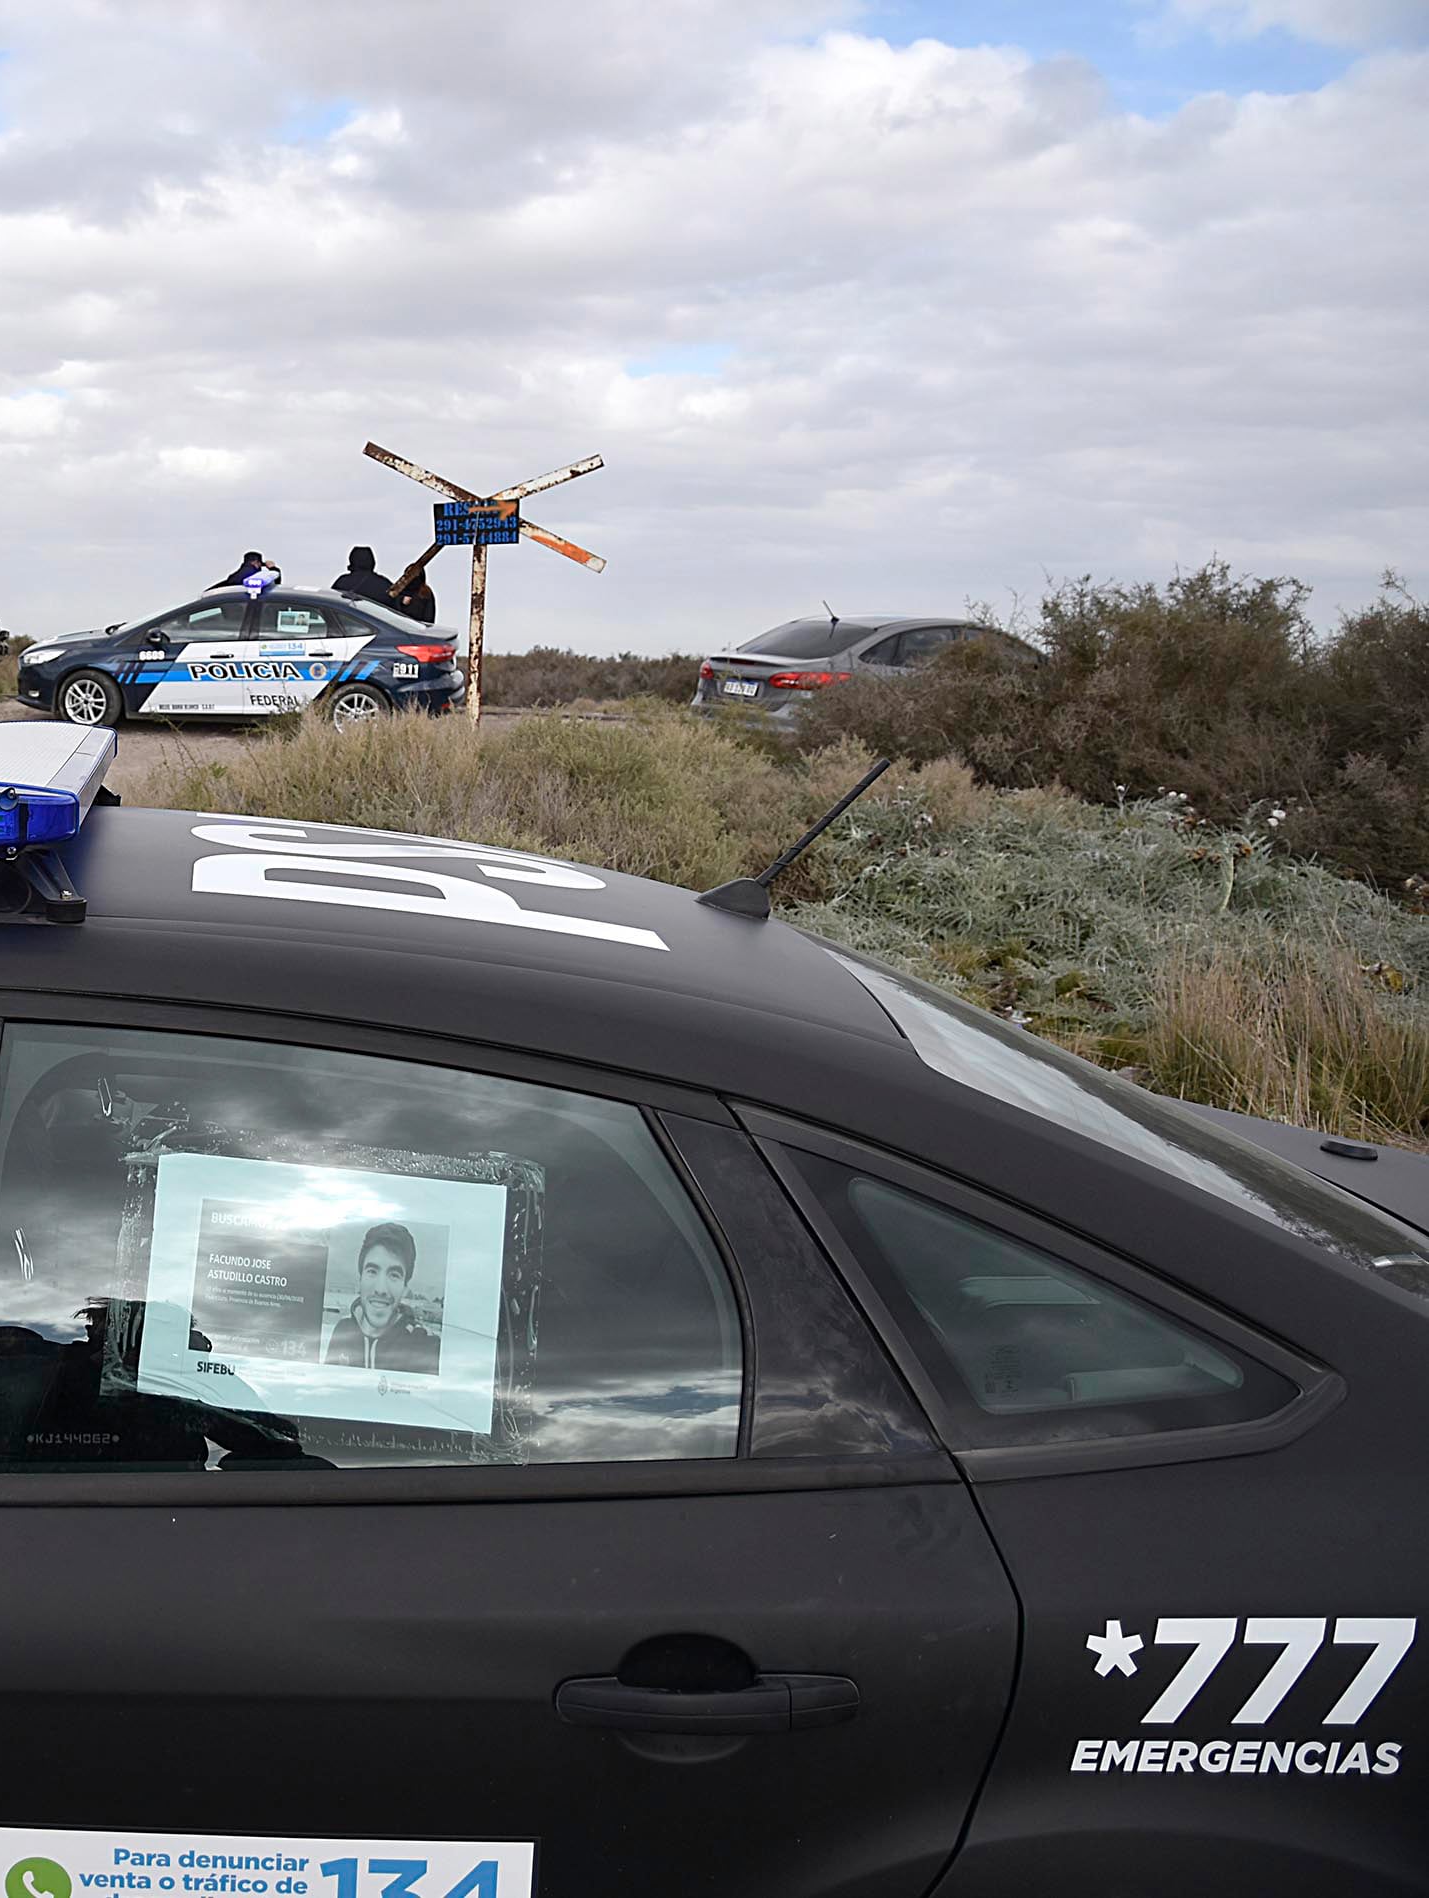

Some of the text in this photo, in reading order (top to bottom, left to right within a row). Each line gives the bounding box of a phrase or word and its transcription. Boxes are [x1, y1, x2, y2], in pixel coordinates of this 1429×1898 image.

[189, 663, 303, 681] POLICIA
[250, 694, 299, 707] FEDERAL
[209, 1253, 272, 1270] FACUNDO JOSE
[207, 1269, 288, 1288] ASTUDILLO CASTRO
[1070, 1740, 1403, 1775] EMERGENCIAS
[113, 1848, 309, 1872] Para denunciar
[79, 1872, 309, 1895] venta o tráfico de
